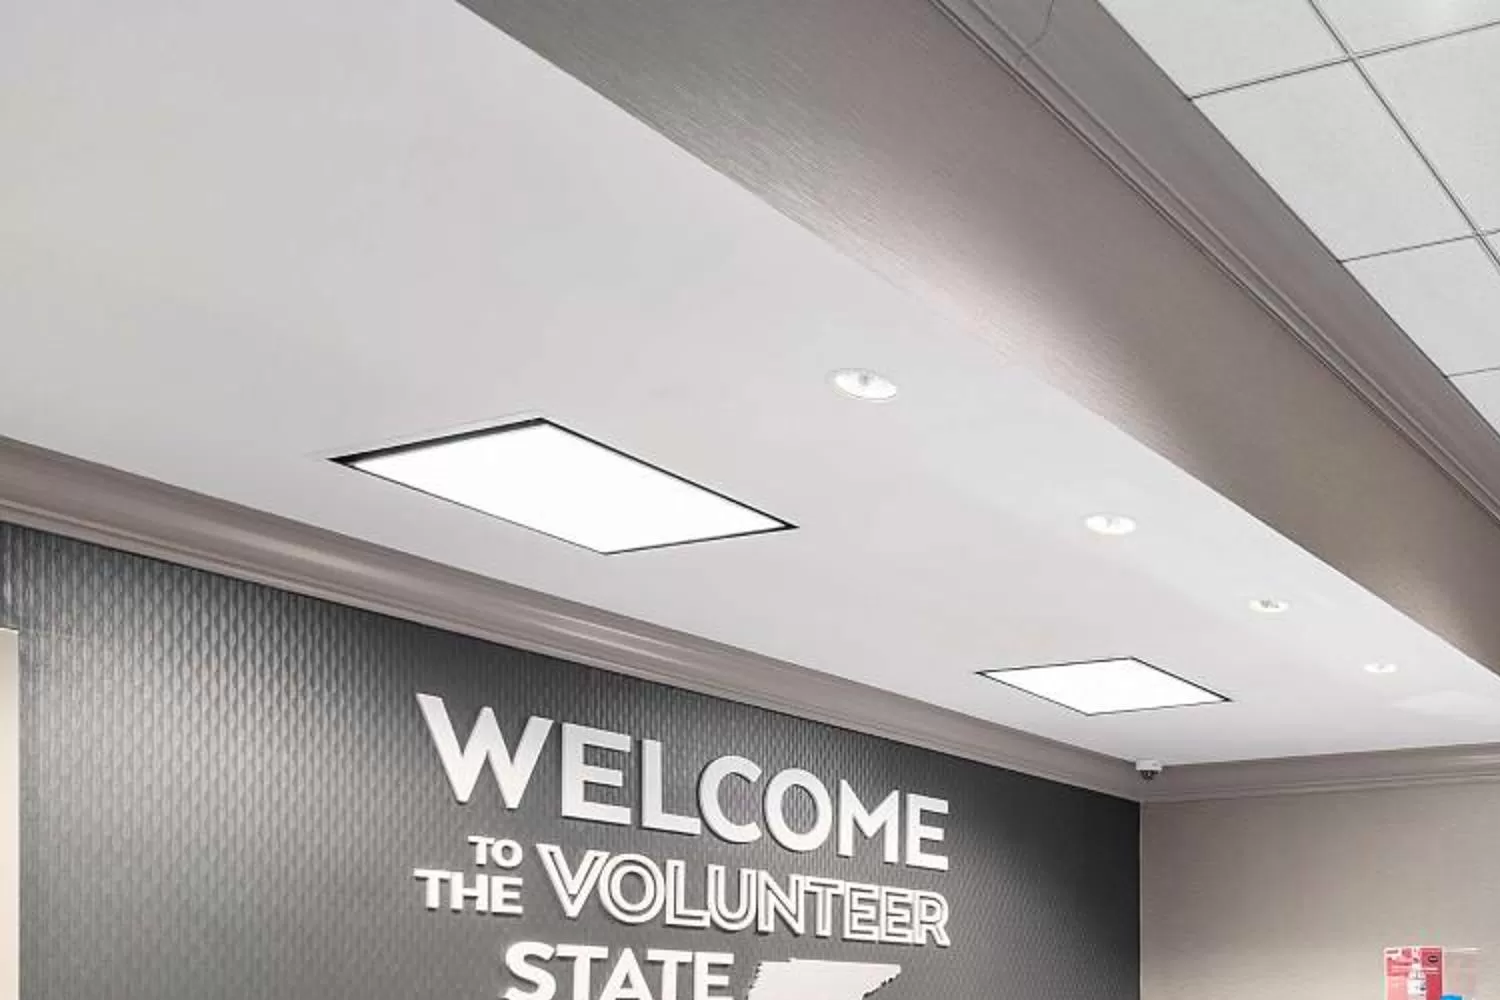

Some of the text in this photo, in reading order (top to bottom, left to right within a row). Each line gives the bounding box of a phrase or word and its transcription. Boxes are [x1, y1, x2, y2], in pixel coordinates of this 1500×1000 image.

[416, 692, 950, 872] WELCOME
[413, 843, 951, 947] THE VOLUNTEER
[467, 835, 523, 868] TO
